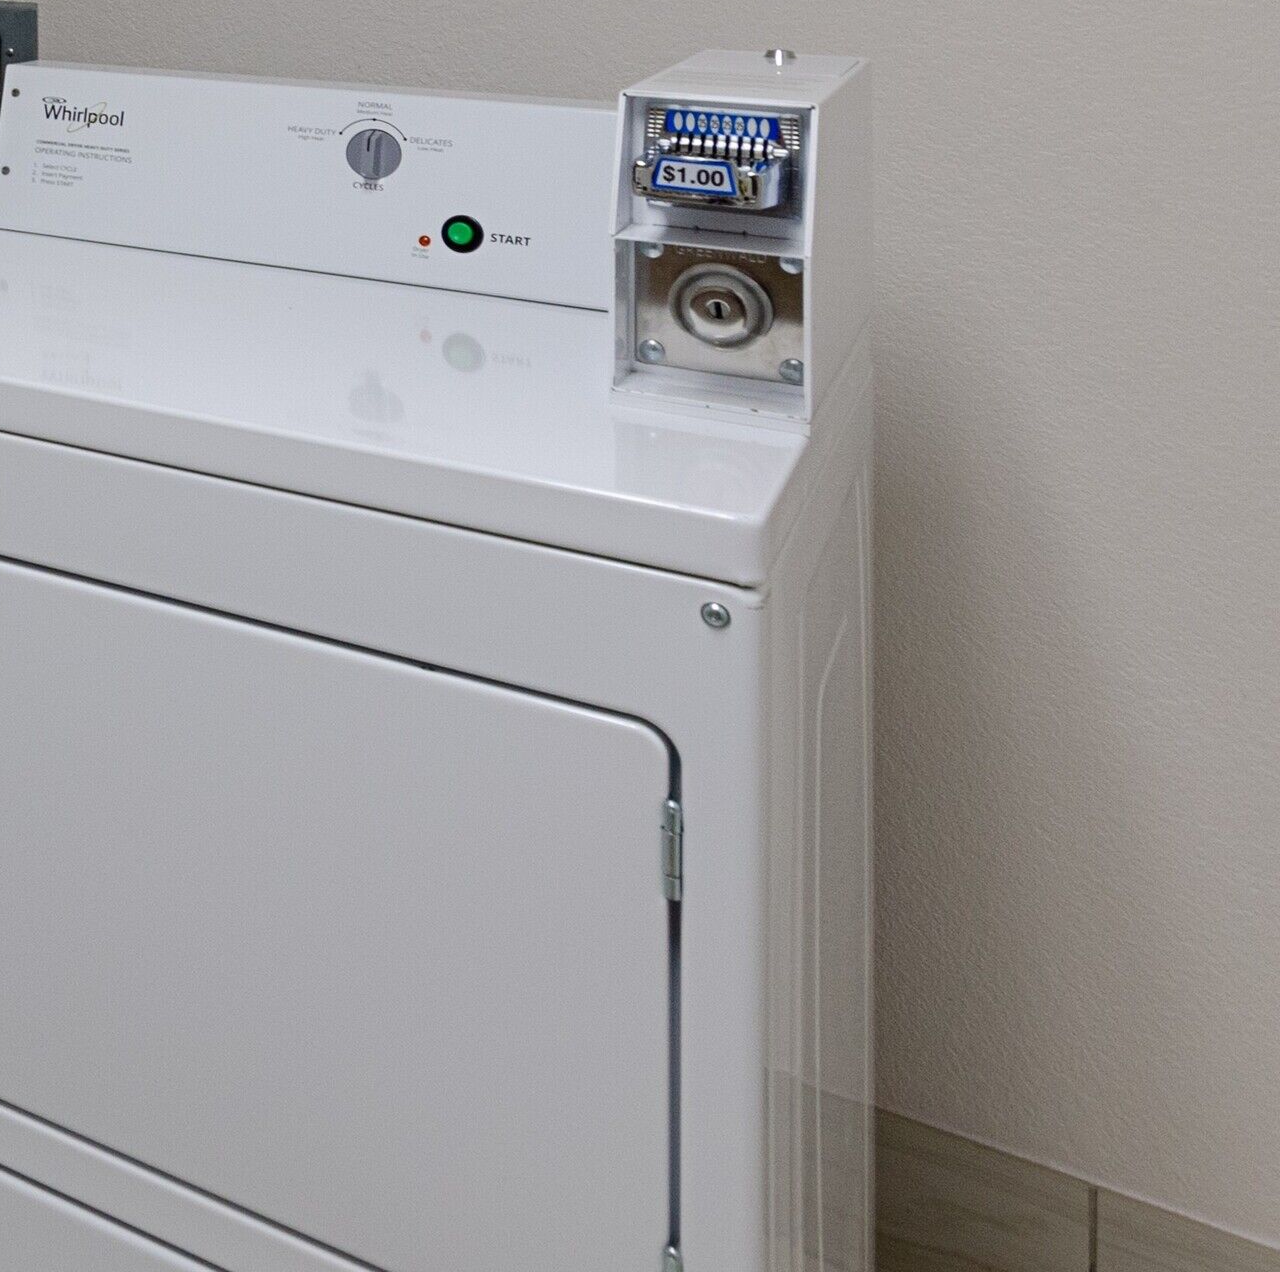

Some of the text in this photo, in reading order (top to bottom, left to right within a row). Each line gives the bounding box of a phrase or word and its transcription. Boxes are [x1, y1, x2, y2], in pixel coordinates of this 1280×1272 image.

[358, 101, 392, 110] NORMAL
[44, 104, 125, 128] Whirlpool
[288, 125, 337, 136] HEAVY DUTY
[409, 136, 453, 148] DELICATES
[35, 147, 132, 164] OPERATING INSTRUCTIONS
[663, 164, 725, 187] $1.00
[352, 181, 384, 191] CYCLES
[490, 233, 531, 246] START
